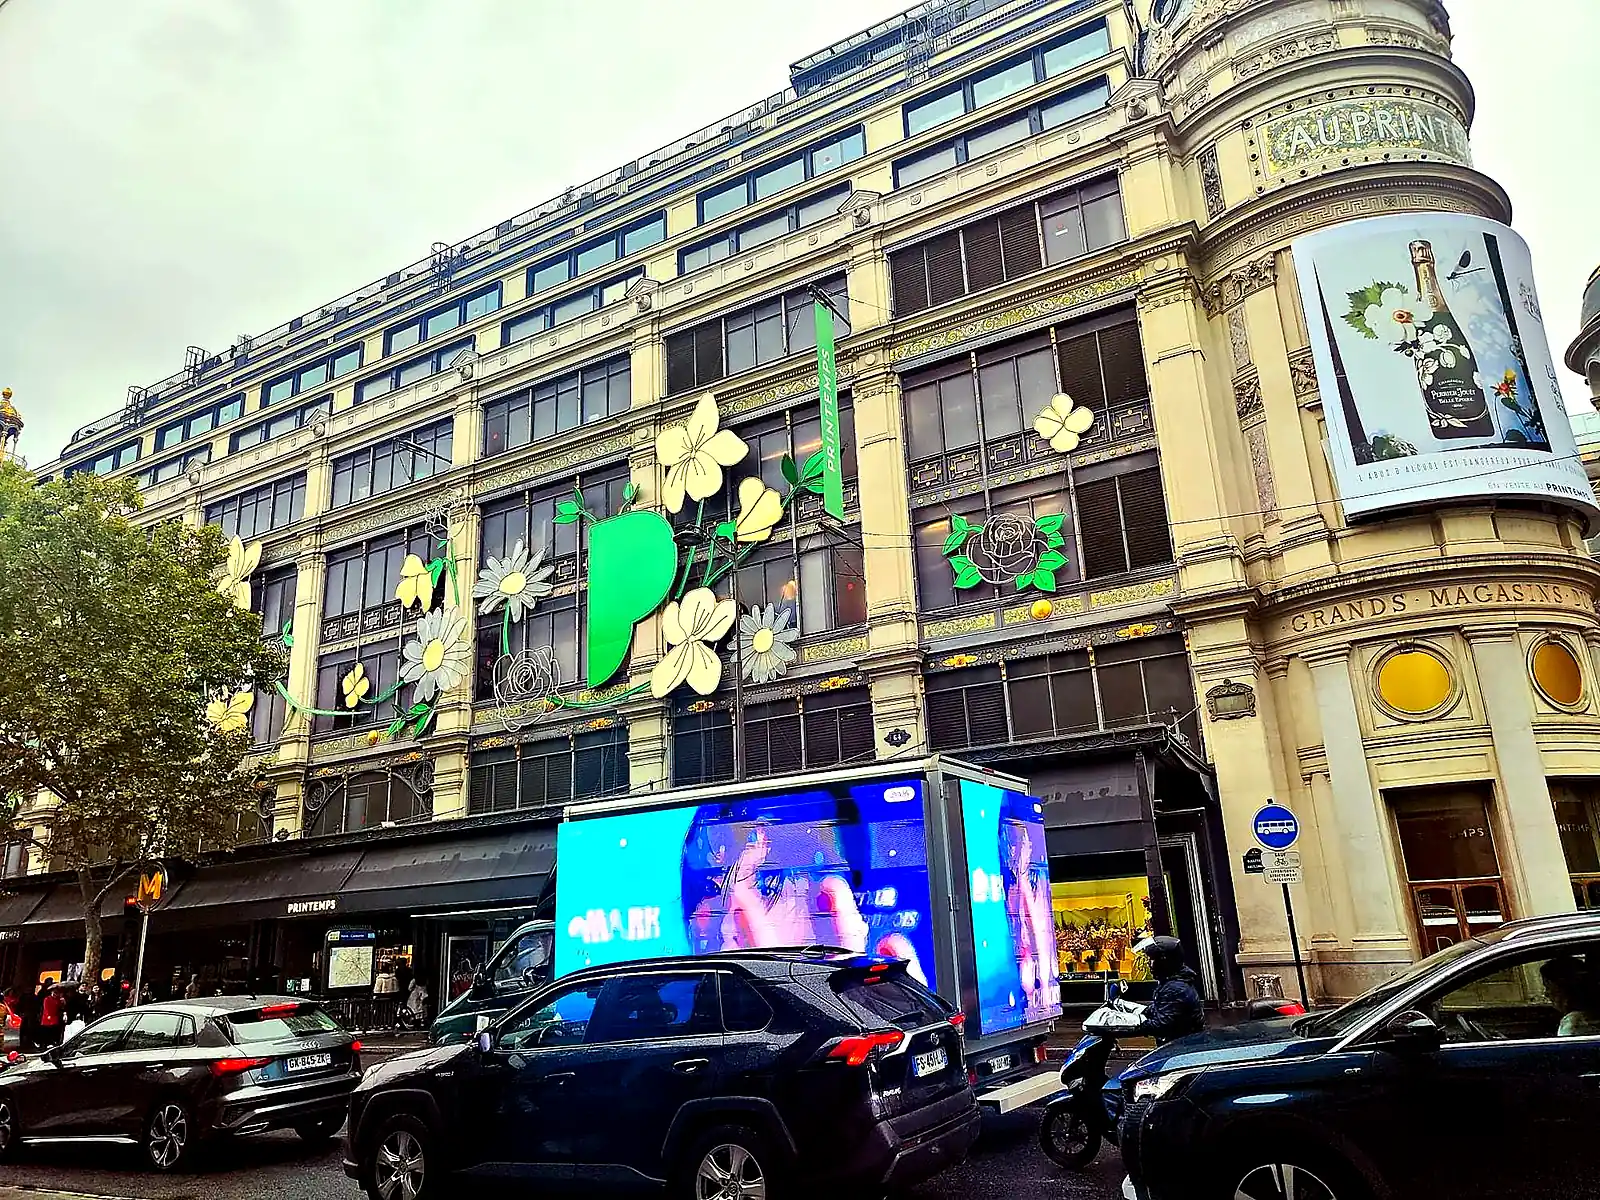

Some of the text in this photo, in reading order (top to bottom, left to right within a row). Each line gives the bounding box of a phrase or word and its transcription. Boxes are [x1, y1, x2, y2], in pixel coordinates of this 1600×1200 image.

[1290, 113, 1341, 157] AU
[821, 348, 836, 472] PRINTEMPS
[1545, 482, 1591, 501] PRINTEMPS
[1291, 593, 1407, 634] GRANDS
[1429, 583, 1563, 608] MAGASINS
[138, 871, 163, 900] M
[287, 899, 336, 914] PRINTEMPS
